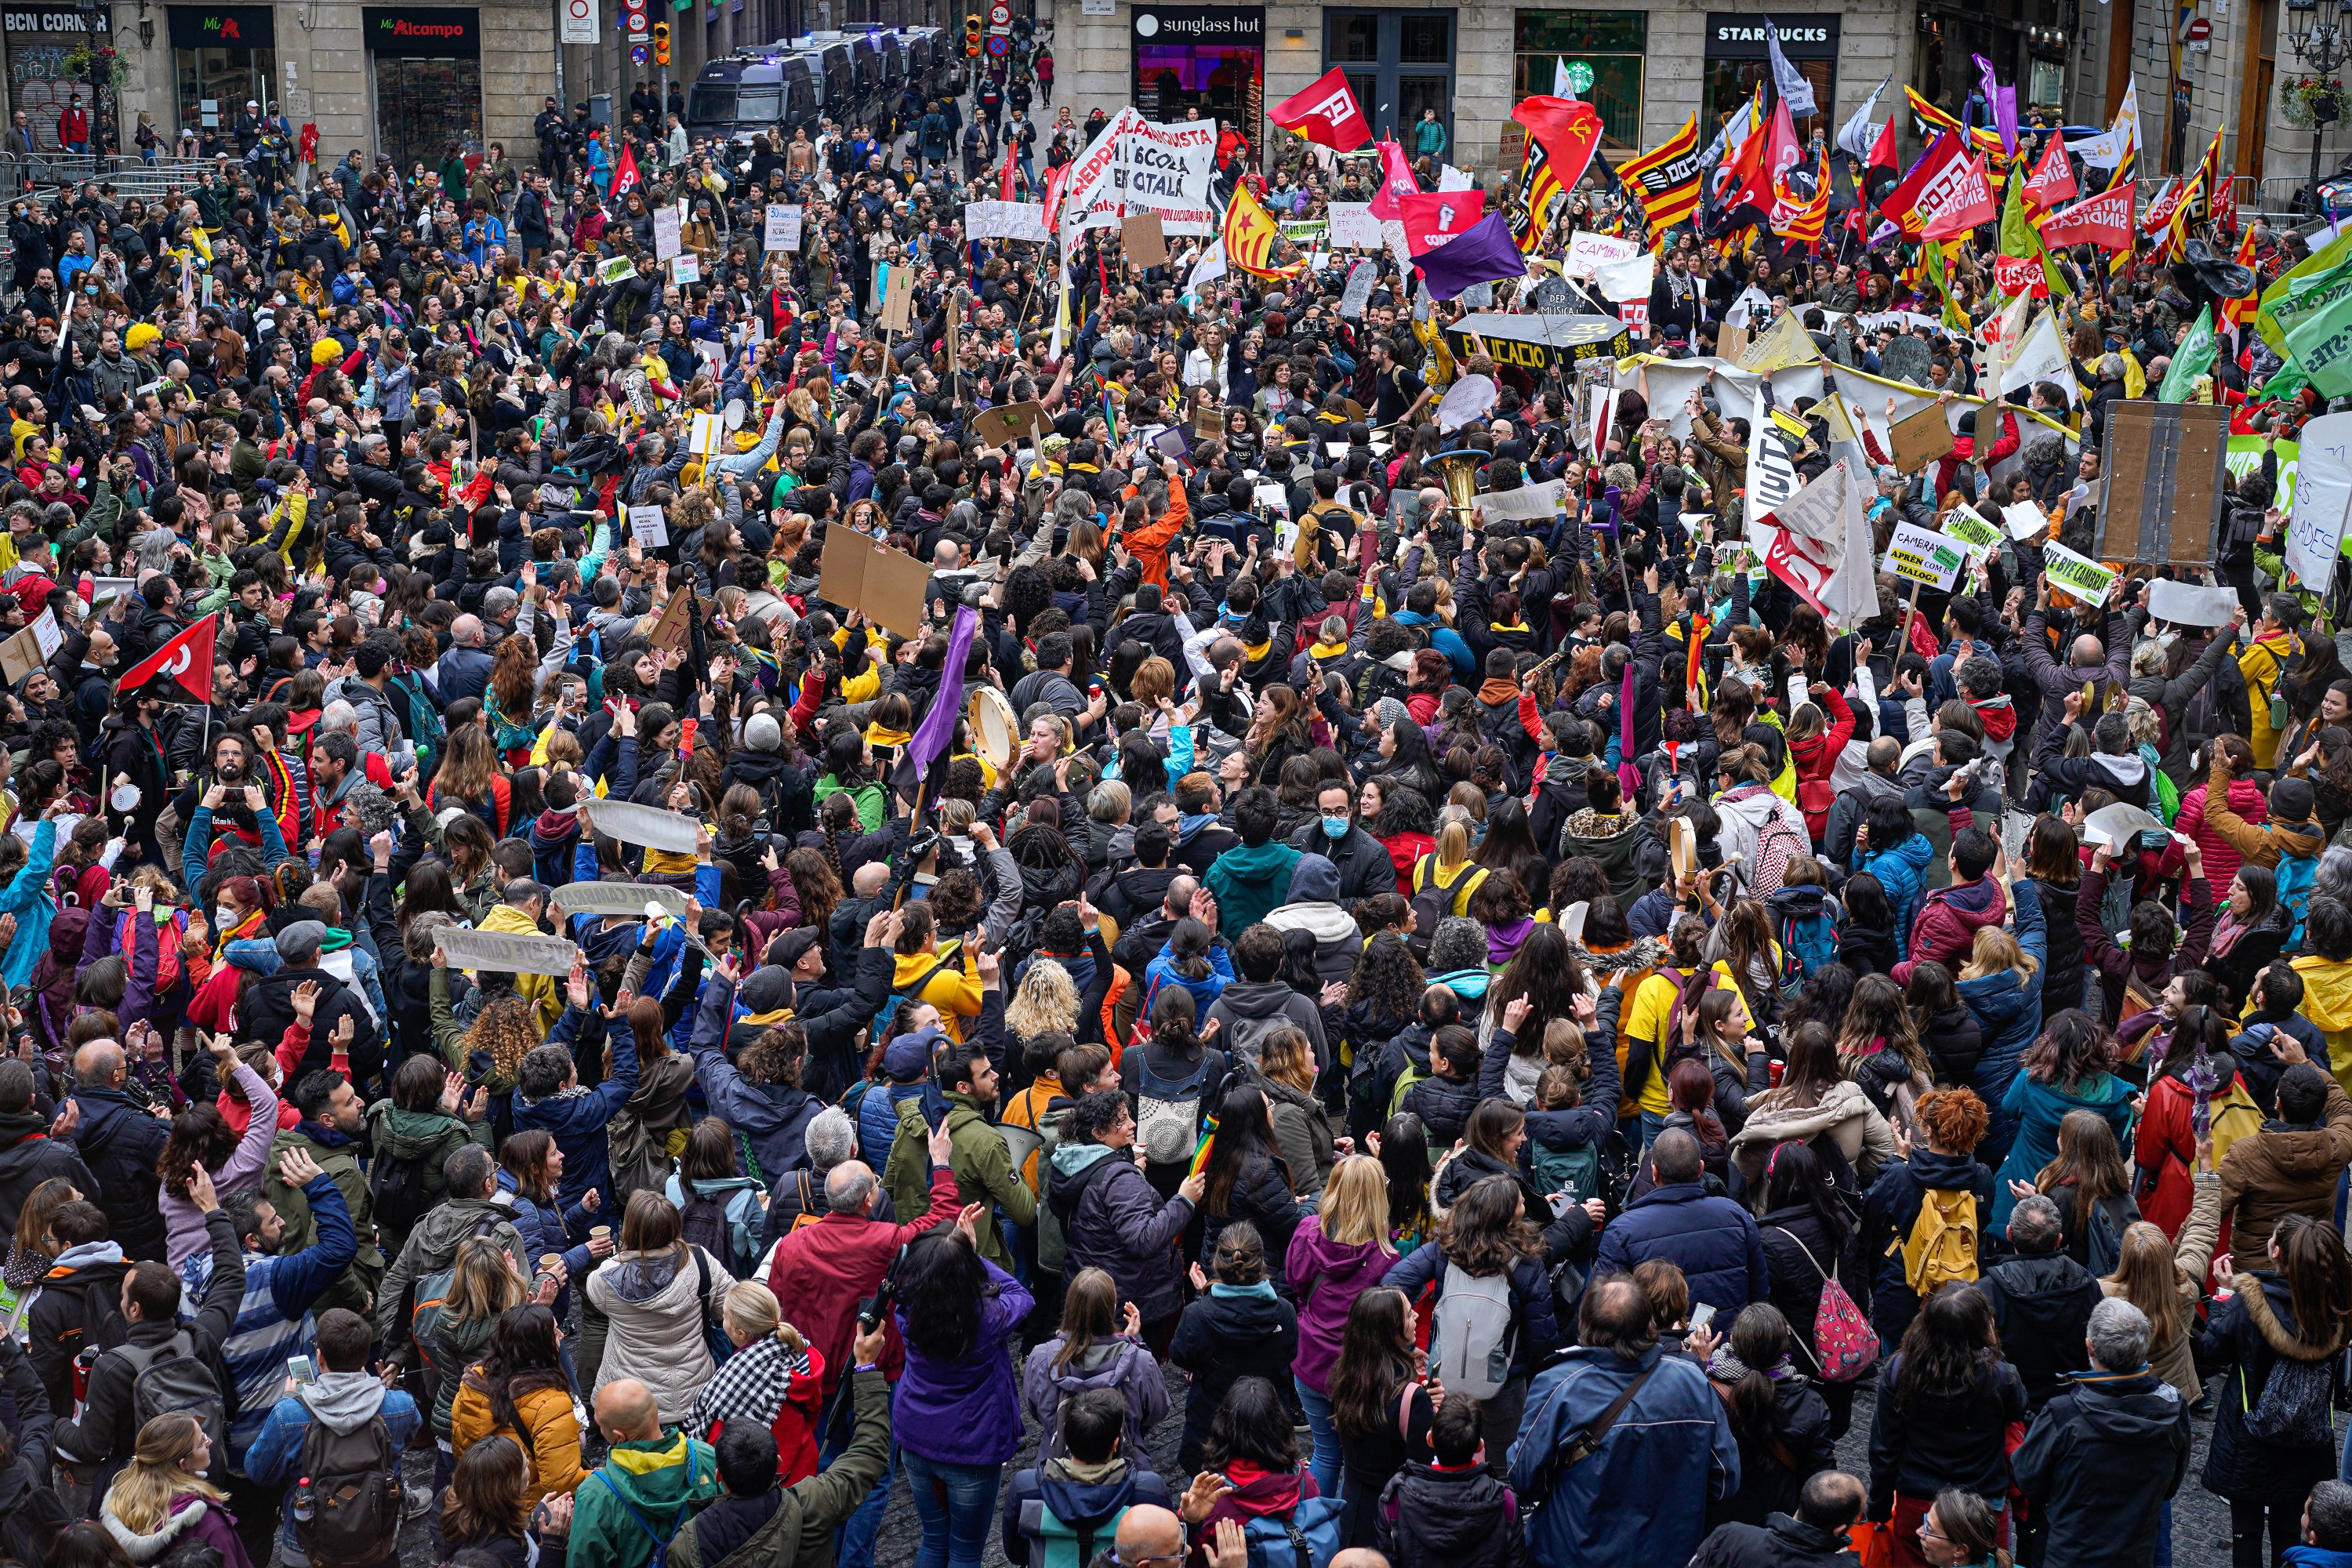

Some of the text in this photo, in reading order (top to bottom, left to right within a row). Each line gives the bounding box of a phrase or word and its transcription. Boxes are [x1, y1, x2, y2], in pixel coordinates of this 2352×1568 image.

[5, 13, 107, 32] BCN CORNR
[204, 16, 221, 30] Mi
[993, 10, 1007, 19] 3,5t
[381, 18, 463, 35] Mi Alcampo
[1163, 16, 1261, 36] sunglass hut
[771, 207, 779, 218] 30
[1290, 224, 1299, 234] BYE
[1300, 223, 1326, 234] CAMBRAY
[1576, 240, 1631, 261] CAMBRAY
[1949, 508, 1997, 550] BYE BYE CAMBRAY
[1896, 532, 1943, 554] CAMBRAY
[1890, 549, 1924, 567] APRÈN
[1924, 561, 1942, 572] COM
[1936, 553, 1955, 568] CENTRES
[1940, 547, 1960, 563] VINE ALS
[1895, 563, 1939, 584] DIALOGA
[2056, 554, 2078, 576] BYE
[2073, 564, 2110, 594] CAMBRAY
